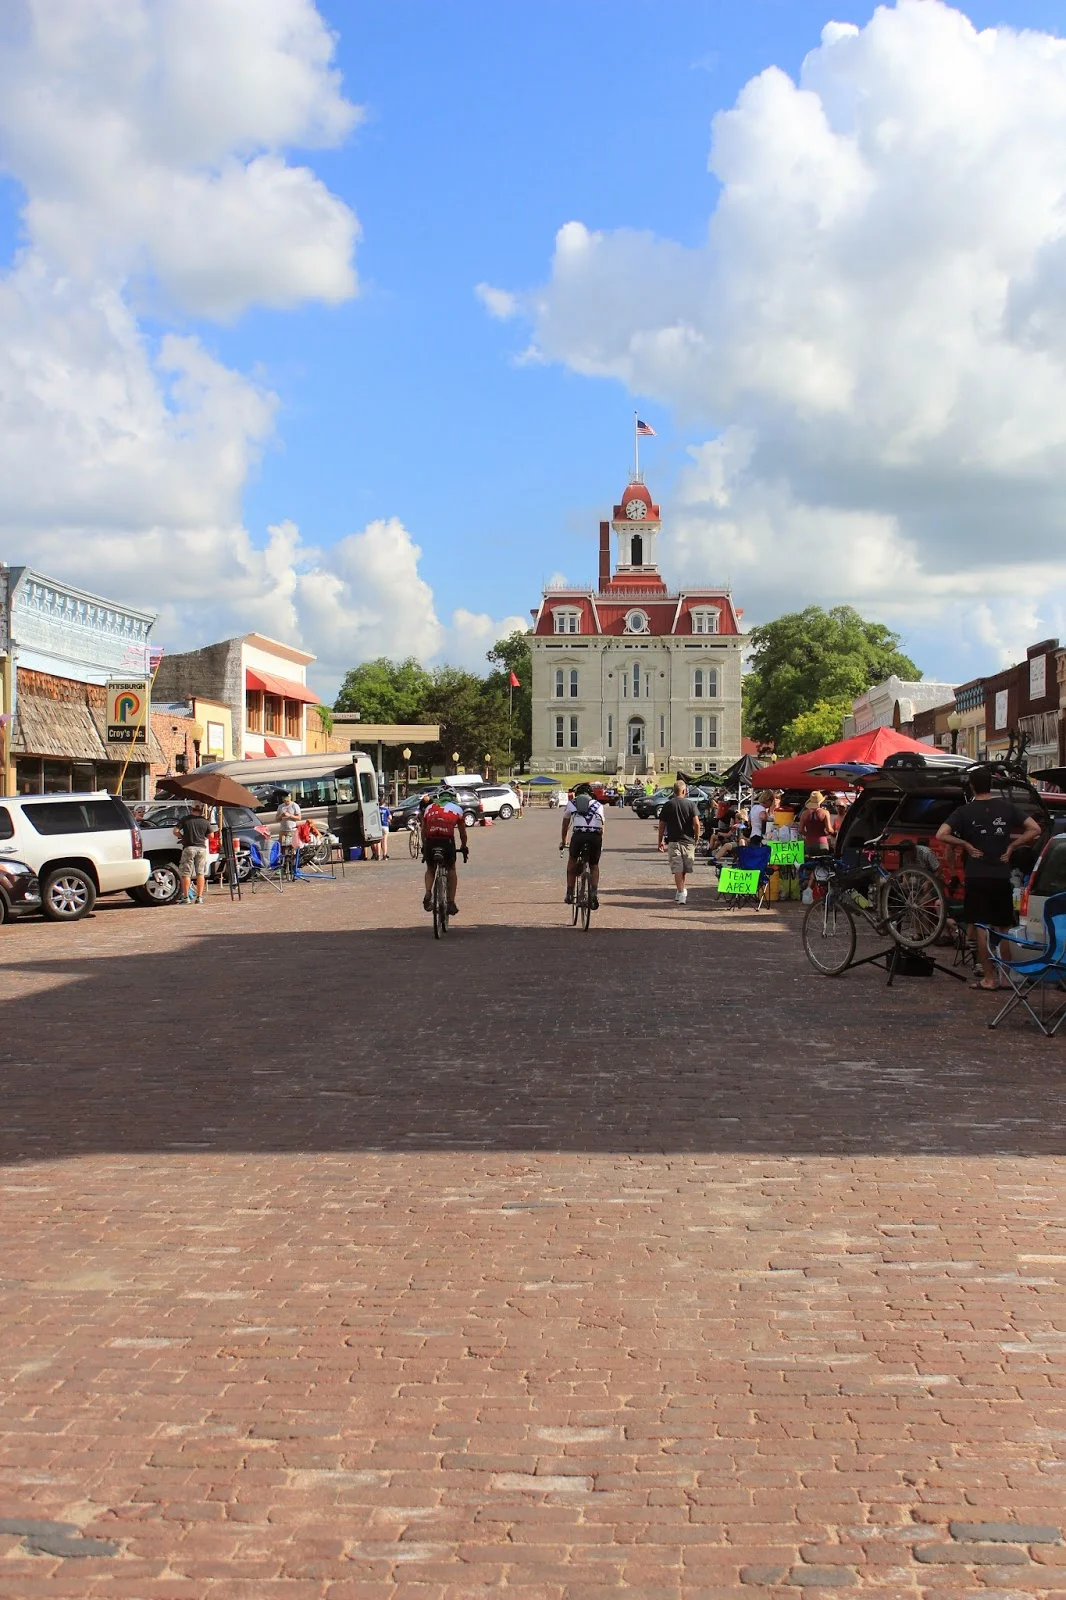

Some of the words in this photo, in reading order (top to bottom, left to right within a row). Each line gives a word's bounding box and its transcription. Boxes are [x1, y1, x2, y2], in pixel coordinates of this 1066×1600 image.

[108, 729, 131, 739] Croy's
[773, 842, 800, 852] TEAM
[773, 853, 799, 864] APEX
[727, 870, 753, 881] TEAM
[725, 882, 752, 892] APEX
